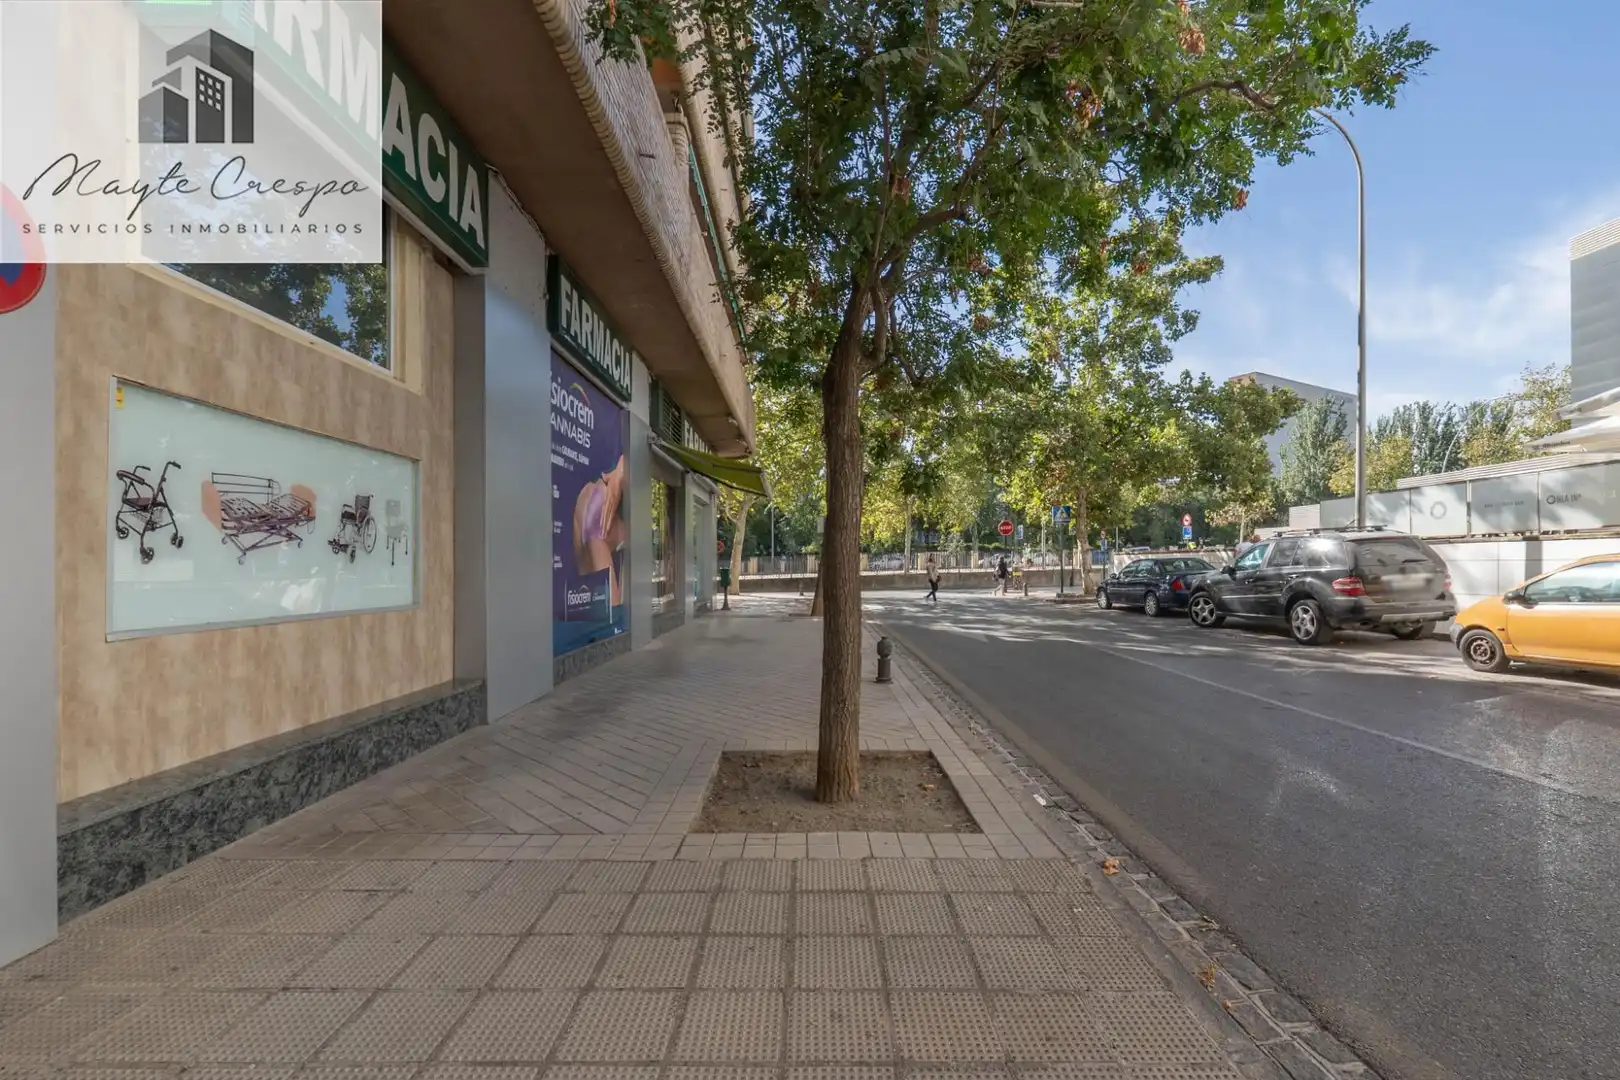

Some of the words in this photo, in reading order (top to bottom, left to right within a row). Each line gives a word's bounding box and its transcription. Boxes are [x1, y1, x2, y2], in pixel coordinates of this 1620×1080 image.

[253, 0, 486, 250] RMACIA
[560, 274, 632, 394] FARMACIA
[550, 376, 594, 430] siocrem
